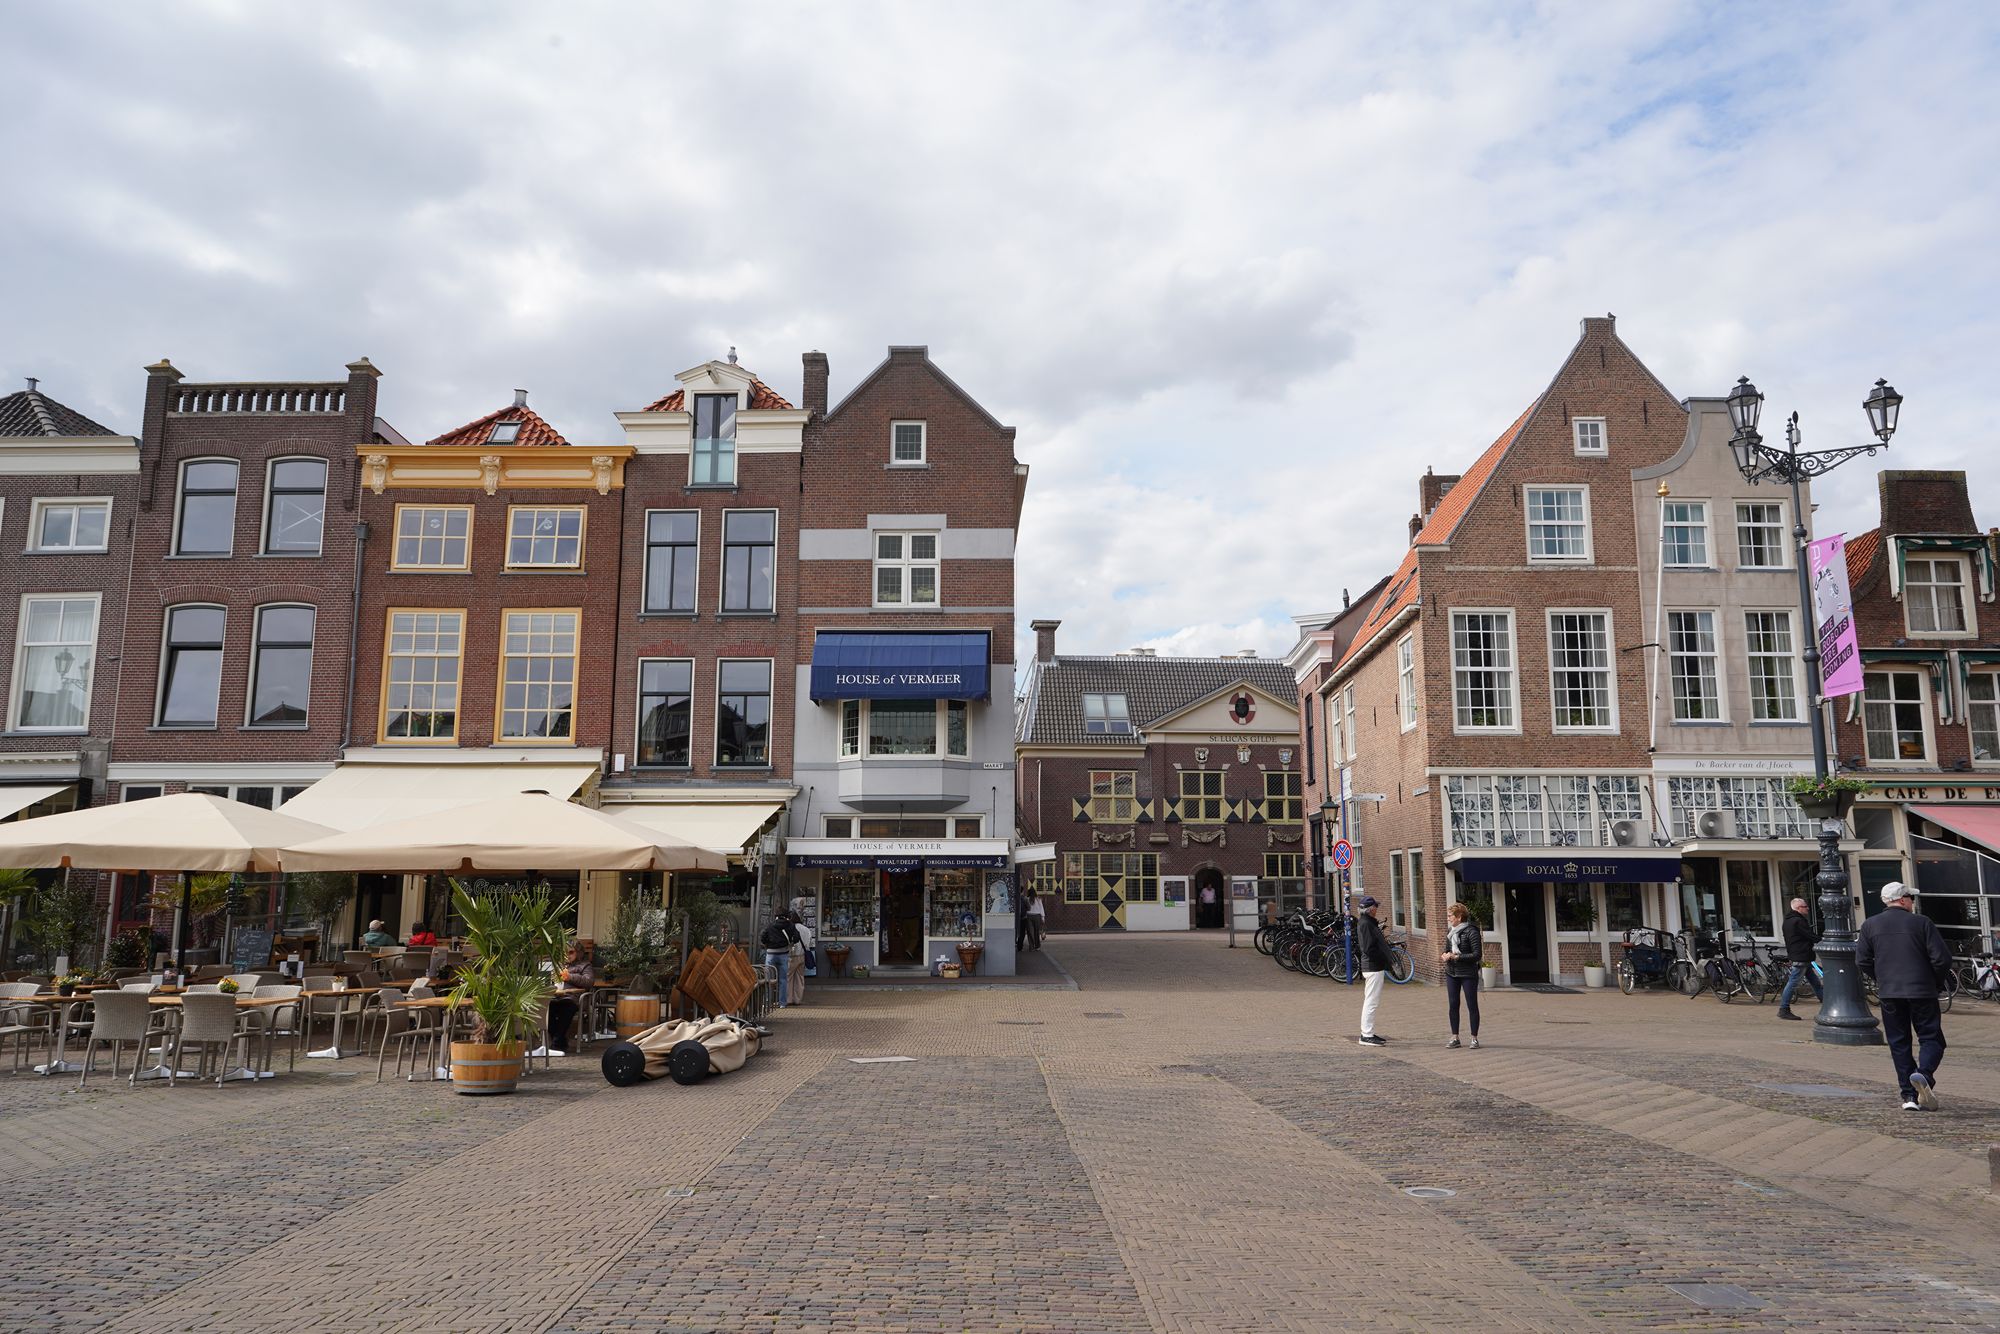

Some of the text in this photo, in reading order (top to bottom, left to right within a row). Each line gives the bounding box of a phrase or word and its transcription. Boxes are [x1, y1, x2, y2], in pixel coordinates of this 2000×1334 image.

[1821, 617, 1834, 635] THE
[1822, 619, 1848, 652] ROBOTS
[1824, 647, 1837, 666] ARE
[1825, 647, 1852, 678] COMING
[836, 674, 961, 685] HOUSE of VERMEER
[1220, 735, 1248, 743] LUCAS
[1250, 735, 1277, 743] GILDE
[1884, 787, 1928, 799] CAFE
[1944, 787, 1967, 799] DE
[1527, 865, 1618, 875] ROYAL DELFT
